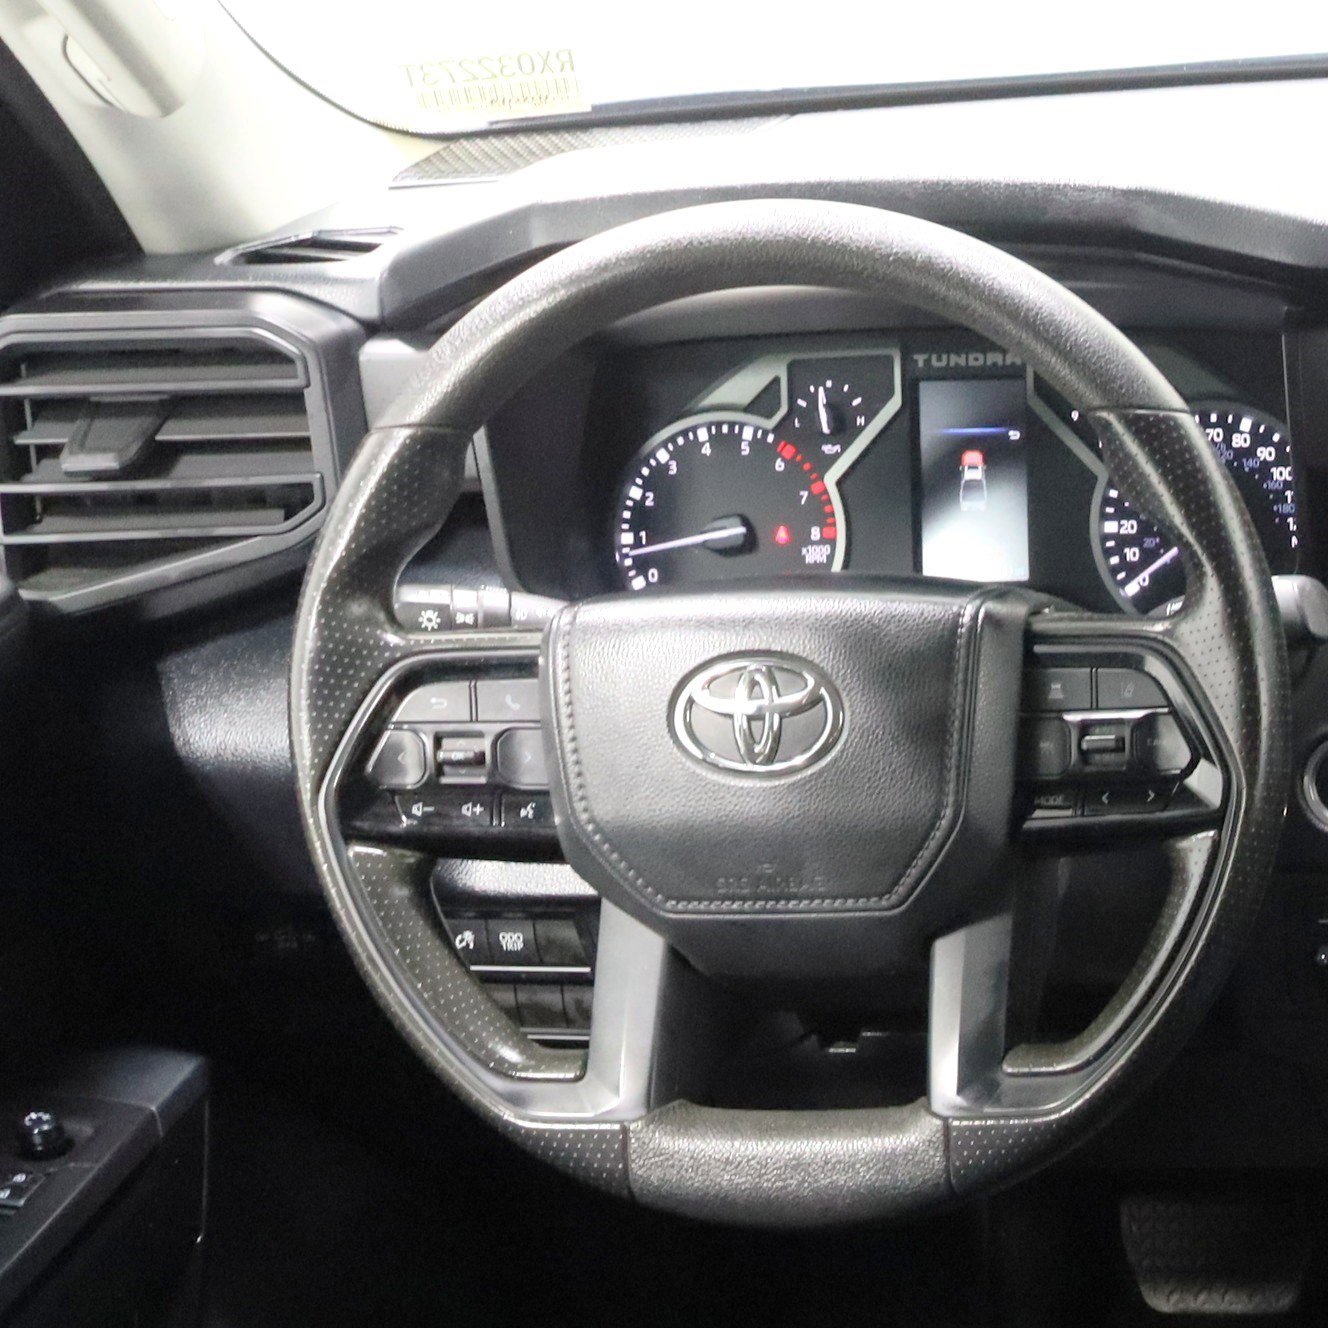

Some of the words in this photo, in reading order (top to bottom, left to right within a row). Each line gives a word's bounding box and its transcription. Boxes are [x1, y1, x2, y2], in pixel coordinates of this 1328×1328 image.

[856, 415, 865, 427] H
[1205, 427, 1224, 442] 70
[1231, 432, 1251, 448] 80
[701, 441, 712, 457] 4
[740, 440, 750, 456] 5
[1256, 446, 1276, 461] 90
[668, 460, 678, 475] 3
[775, 459, 785, 472] 6
[1270, 466, 1293, 481] 100
[644, 491, 655, 507] 2
[799, 490, 809, 505] 7
[810, 525, 821, 541] 8
[1119, 519, 1138, 534] 20
[638, 530, 647, 545] 1
[1123, 547, 1140, 562] 10
[648, 567, 659, 583] 0
[499, 931, 524, 942] ODO
